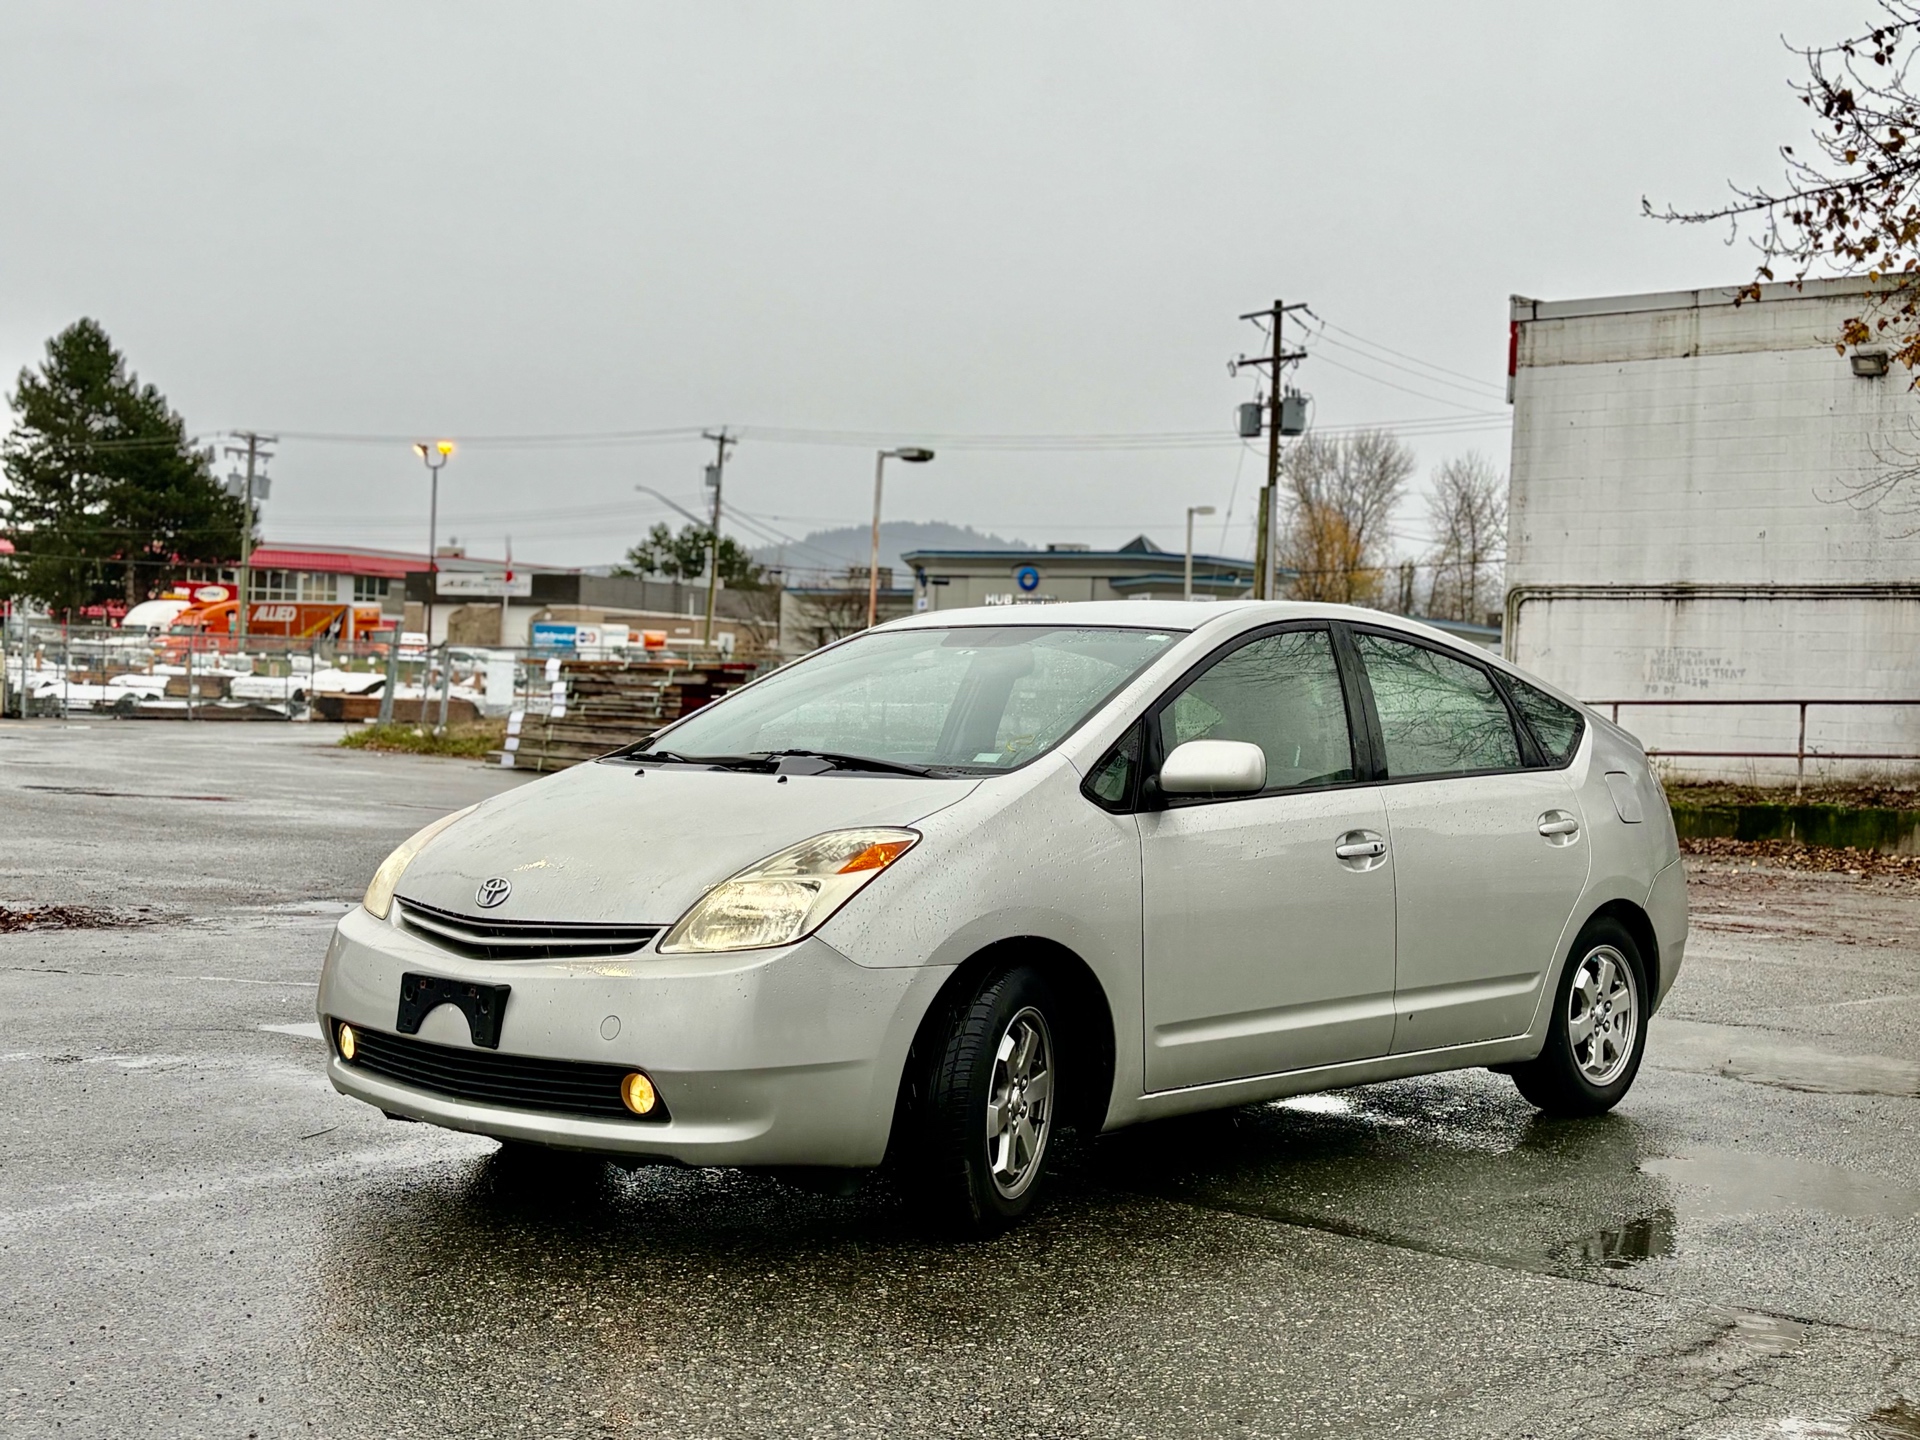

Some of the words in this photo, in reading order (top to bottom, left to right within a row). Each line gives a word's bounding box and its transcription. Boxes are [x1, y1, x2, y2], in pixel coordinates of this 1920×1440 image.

[985, 594, 1013, 605] HUB
[252, 605, 297, 622] ALLIED
[1713, 668, 1746, 679] THAT
